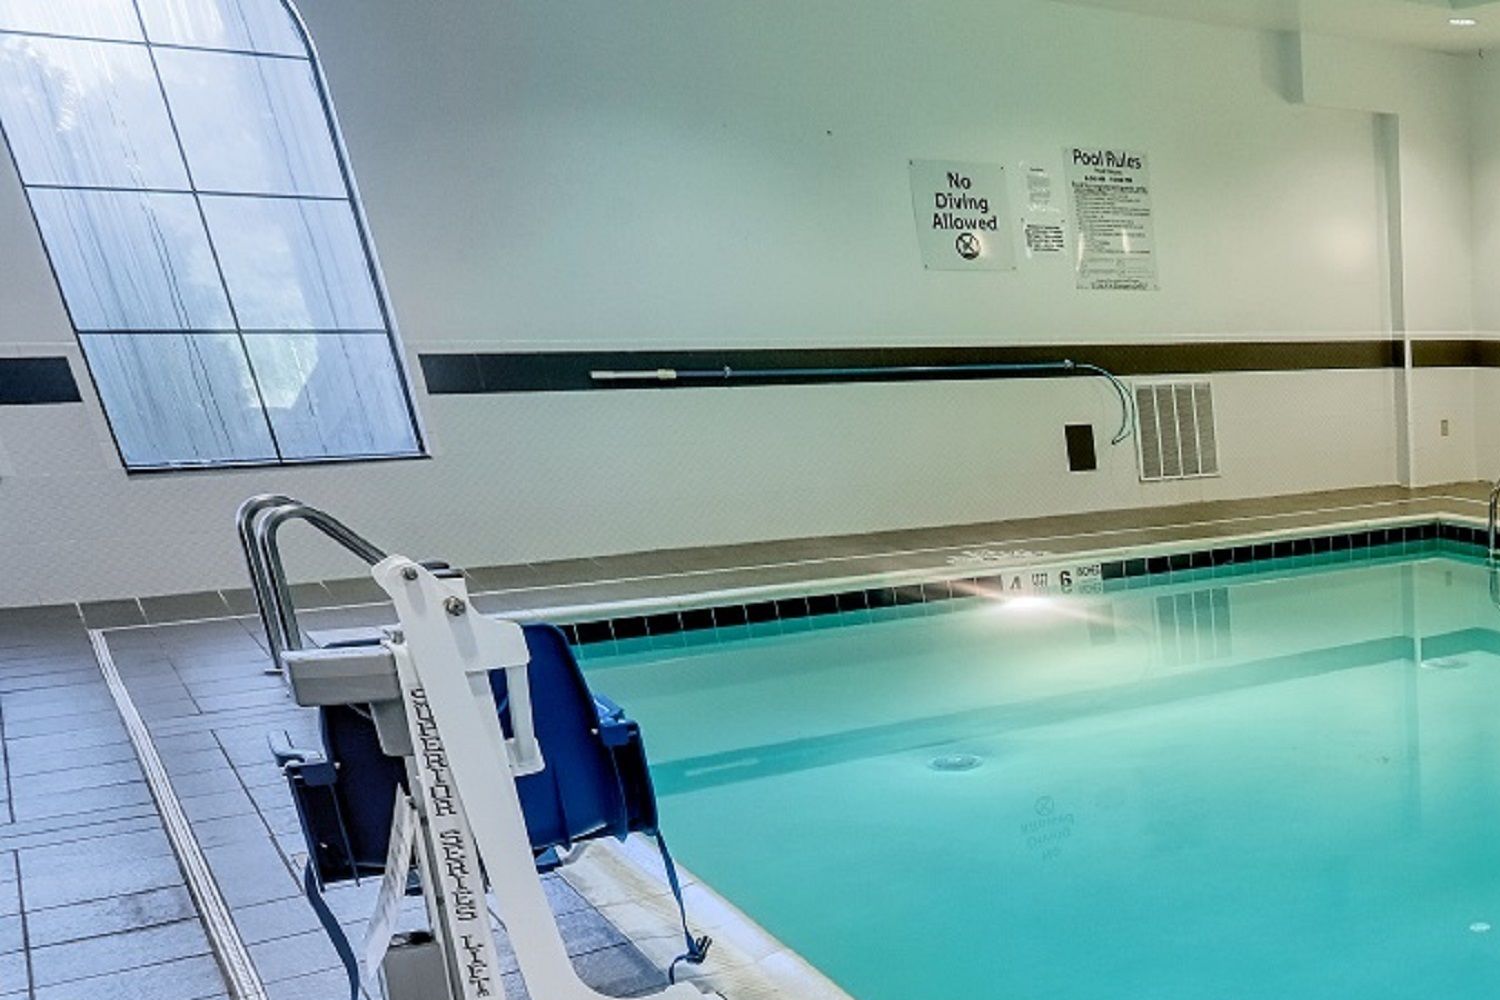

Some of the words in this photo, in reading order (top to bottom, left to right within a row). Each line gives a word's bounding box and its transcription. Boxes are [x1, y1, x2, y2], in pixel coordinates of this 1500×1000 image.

[1072, 149, 1103, 166] Pool
[1105, 151, 1142, 169] Rules
[947, 171, 971, 190] No
[935, 192, 988, 214] Diving
[933, 212, 997, 231] Allowed
[440, 829, 477, 921] SERIES
